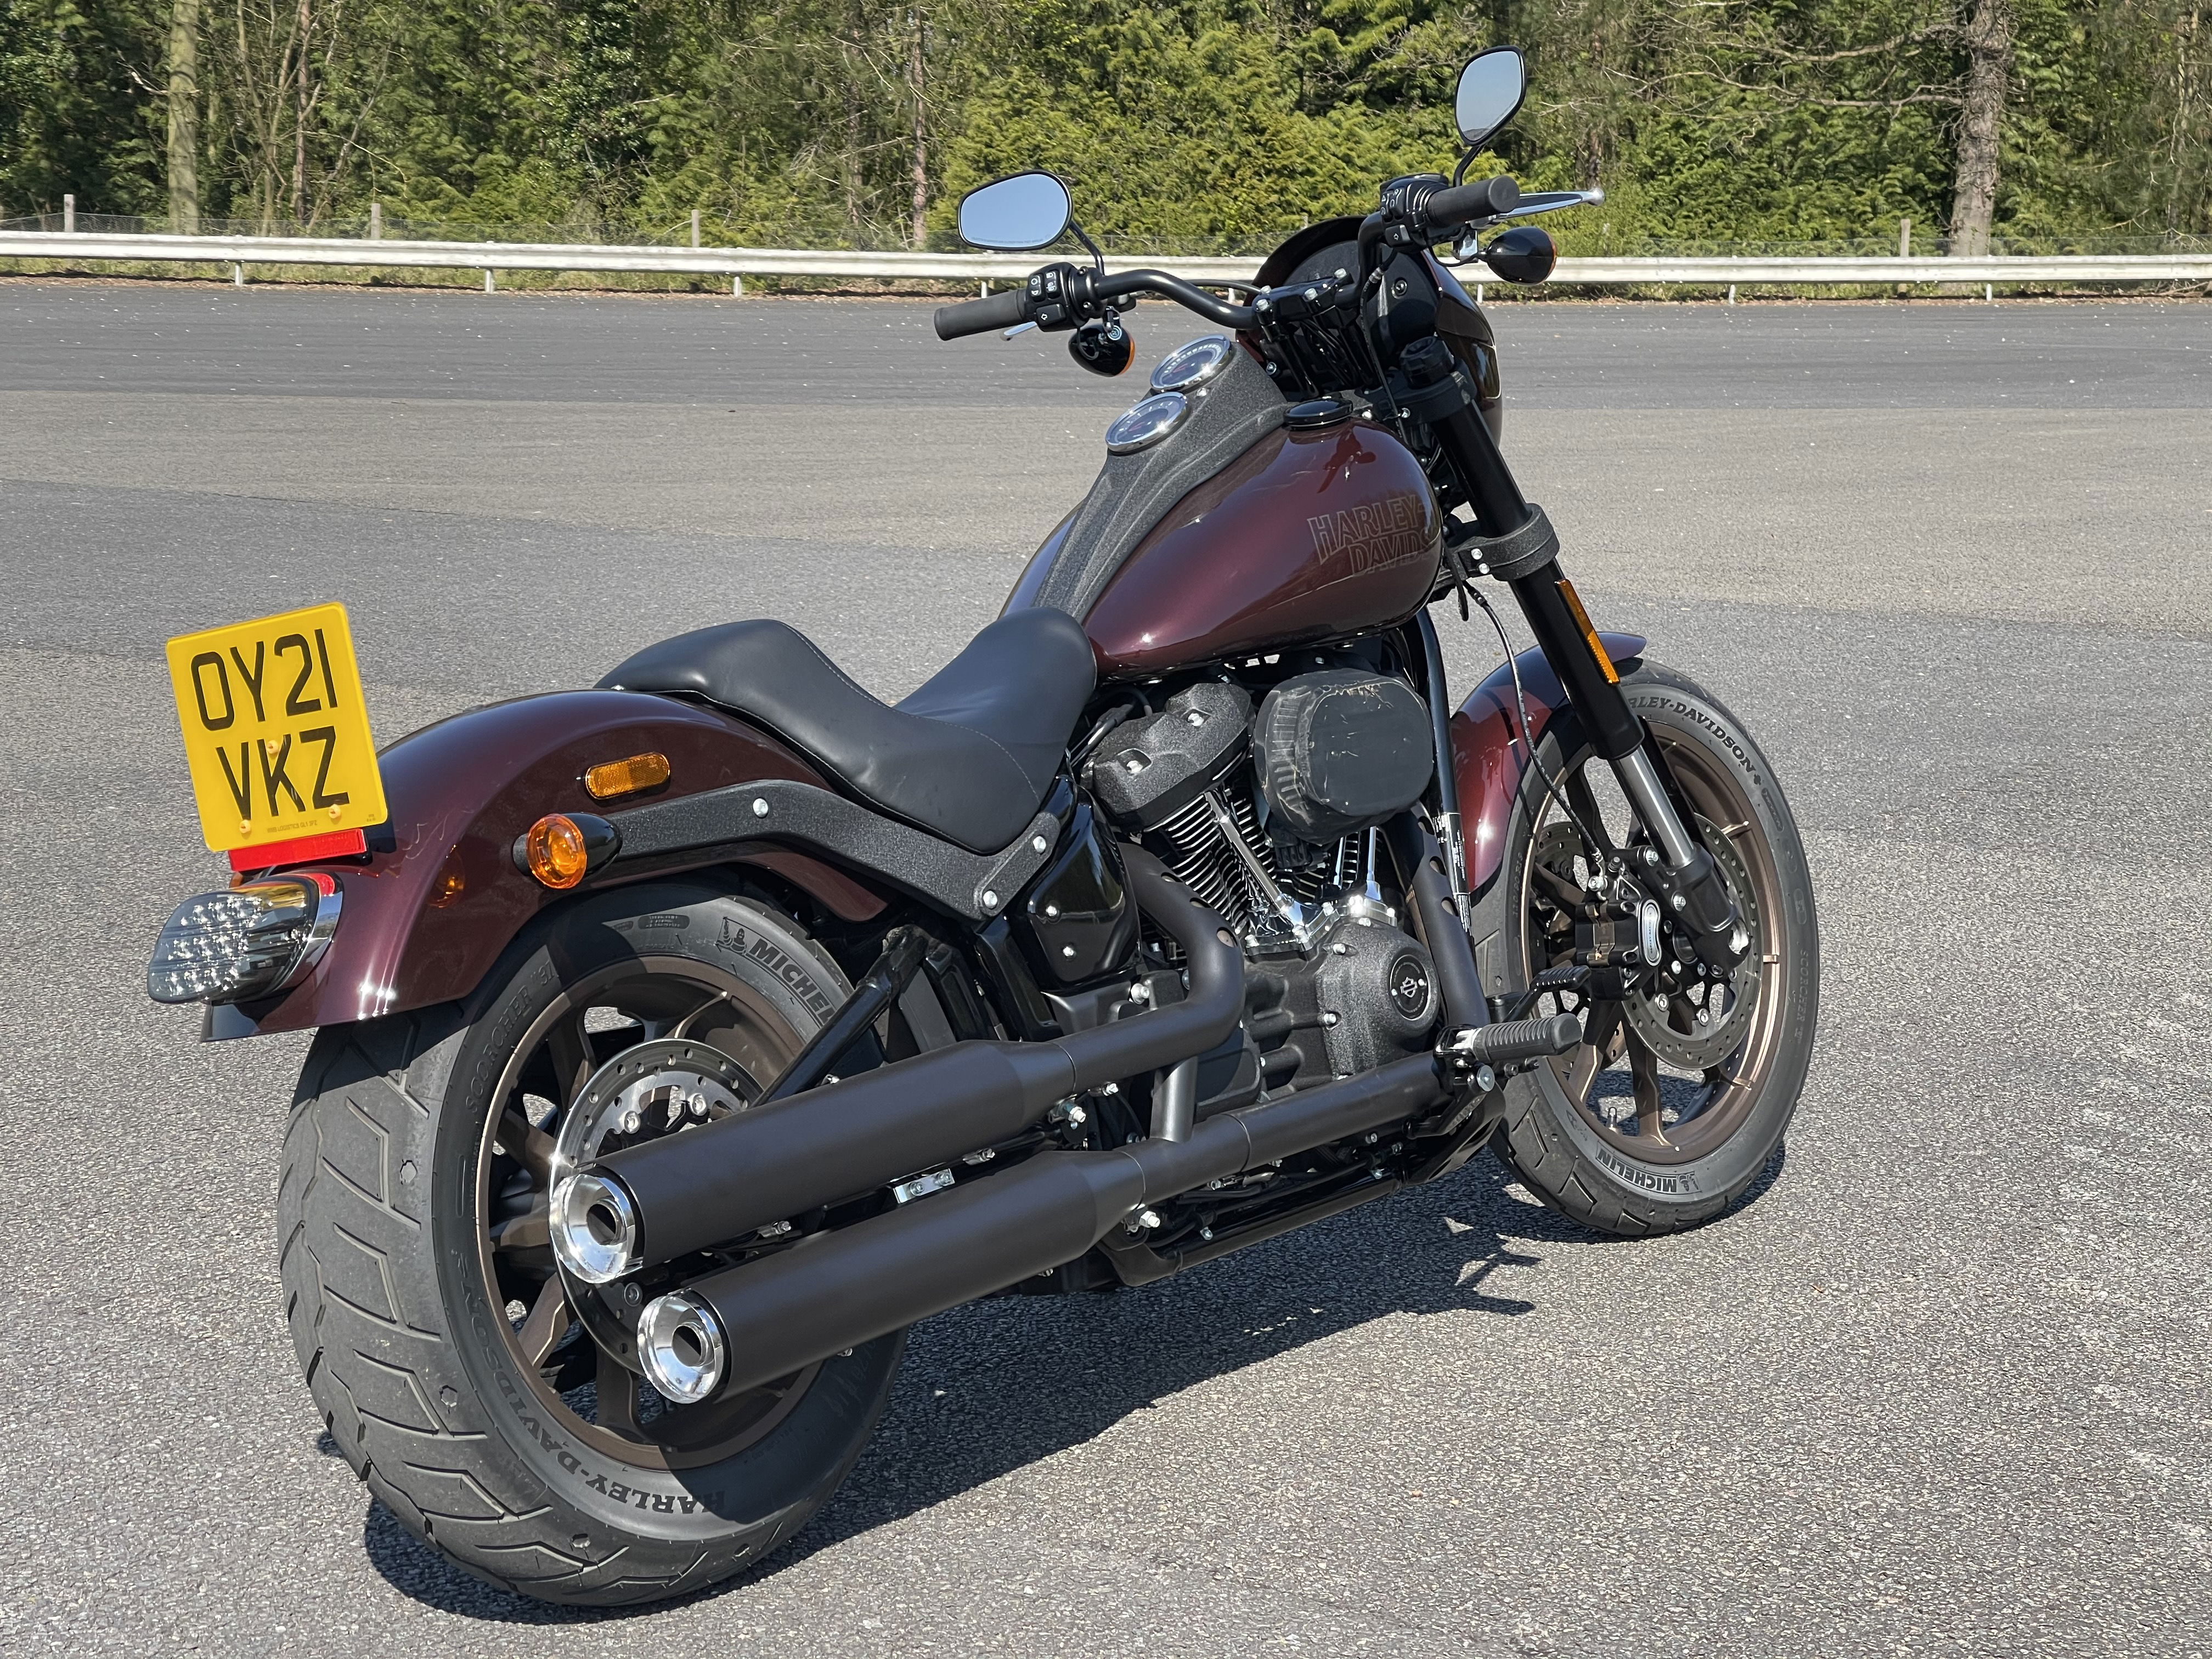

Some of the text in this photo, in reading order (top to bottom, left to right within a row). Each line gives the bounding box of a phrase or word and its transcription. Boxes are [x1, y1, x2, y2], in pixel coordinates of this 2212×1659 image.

[190, 628, 338, 731] OY21
[215, 725, 350, 821] VKZ
[1596, 1147, 1677, 1193] MICHELIN
